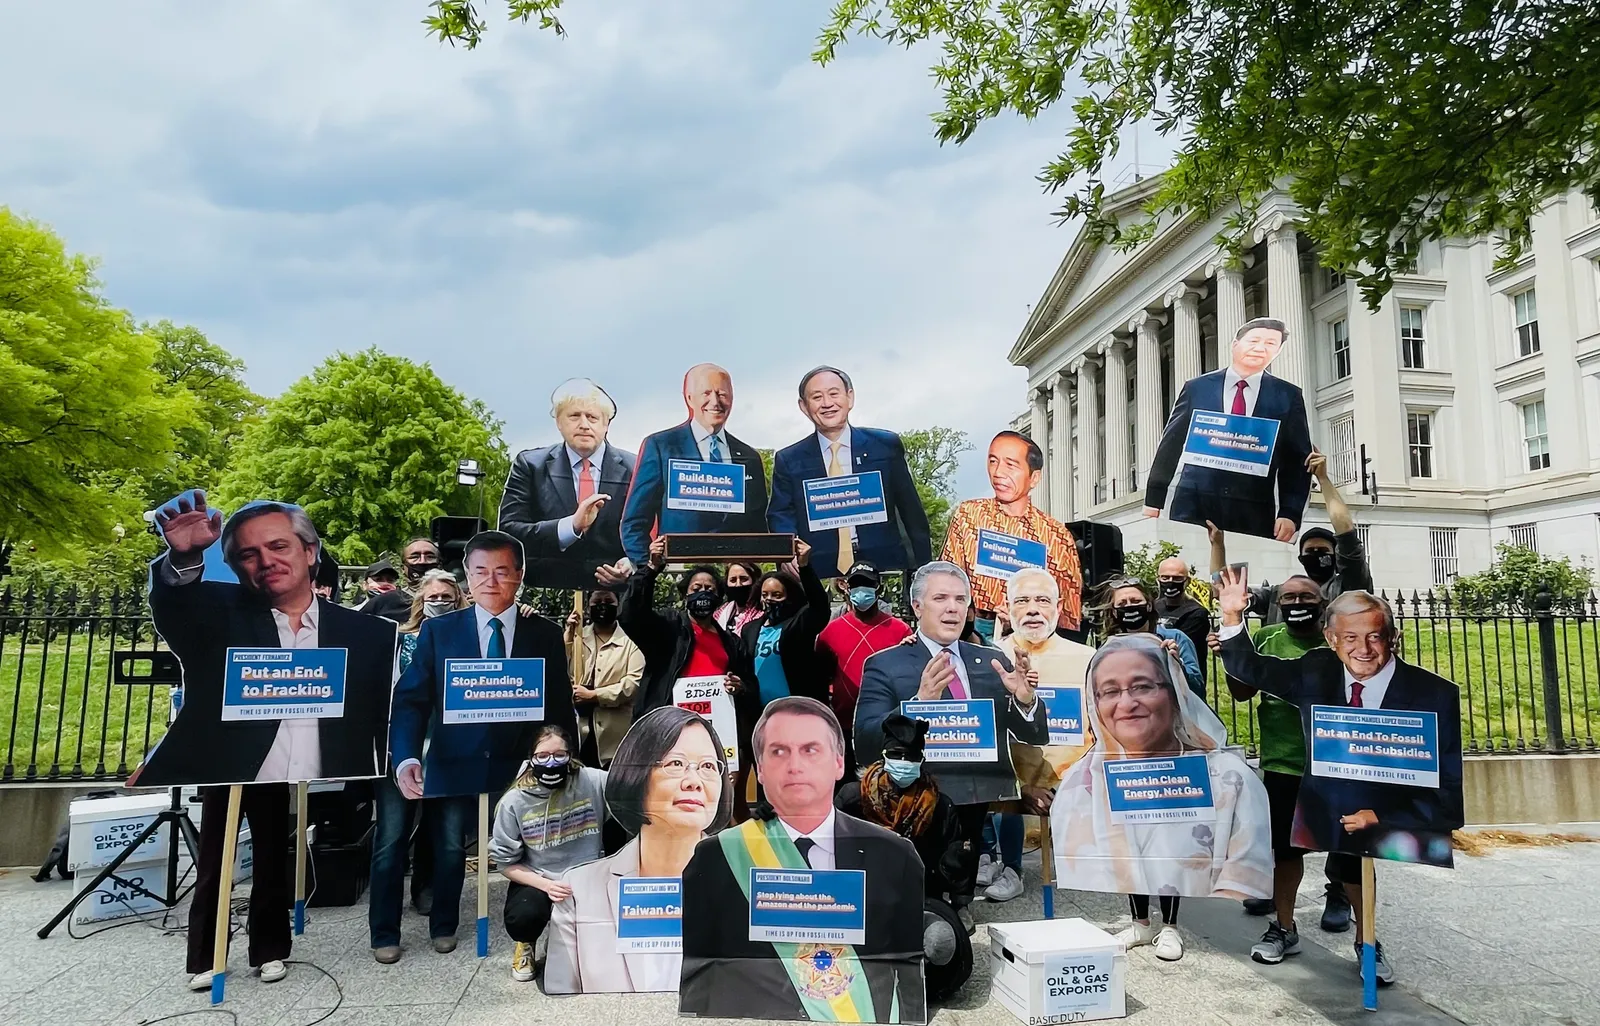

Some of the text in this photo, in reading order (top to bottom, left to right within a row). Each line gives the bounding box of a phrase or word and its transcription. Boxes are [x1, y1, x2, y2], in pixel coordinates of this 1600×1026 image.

[1209, 429, 1234, 439] Climate
[1210, 437, 1232, 446] Divest
[1232, 440, 1249, 449] from
[678, 472, 732, 485] Build Back
[680, 485, 733, 497] Fossil Free
[810, 493, 830, 502] Divest
[815, 502, 834, 510] Invest
[860, 496, 882, 505] Future
[983, 541, 1009, 554] Deliver
[990, 552, 1007, 562] Just
[241, 665, 324, 679] Put an End
[451, 675, 523, 688] Stop Funding
[686, 680, 719, 688] PRESIDENT
[242, 682, 332, 698] to Fracking
[464, 687, 539, 699] Overseas Coal
[684, 688, 723, 699] BIDEN:
[948, 715, 980, 726] Start
[1047, 717, 1077, 729] ergy
[924, 730, 976, 744] Fracking
[1316, 727, 1424, 744] Put an End To Fossil
[1349, 743, 1432, 759] Fuel Subsidies
[1328, 766, 1341, 774] TIME
[1373, 770, 1395, 778] FOSSIL
[1396, 772, 1416, 780] FUELS
[1116, 775, 1190, 788] Invest in Clean
[1123, 786, 1204, 800] Energy, Not Gas
[110, 823, 145, 833] STOP
[94, 829, 158, 842] OIL & GS
[96, 836, 156, 850] EXPOS
[113, 877, 144, 890] NO
[756, 891, 775, 900] Stop
[775, 892, 795, 900] lying
[795, 892, 818, 900] about
[622, 904, 682, 916] Taiwan Ca
[757, 900, 857, 911] Amazon and the pandemic.
[795, 930, 805, 938] FOR
[807, 930, 826, 938] FOSSIL
[827, 931, 844, 939] FUELS
[1062, 964, 1096, 975] STOP
[1047, 973, 1109, 986] OIL & GAS
[1050, 984, 1107, 997] EXPORTS
[1029, 1011, 1087, 1026] BASIC DUTY
